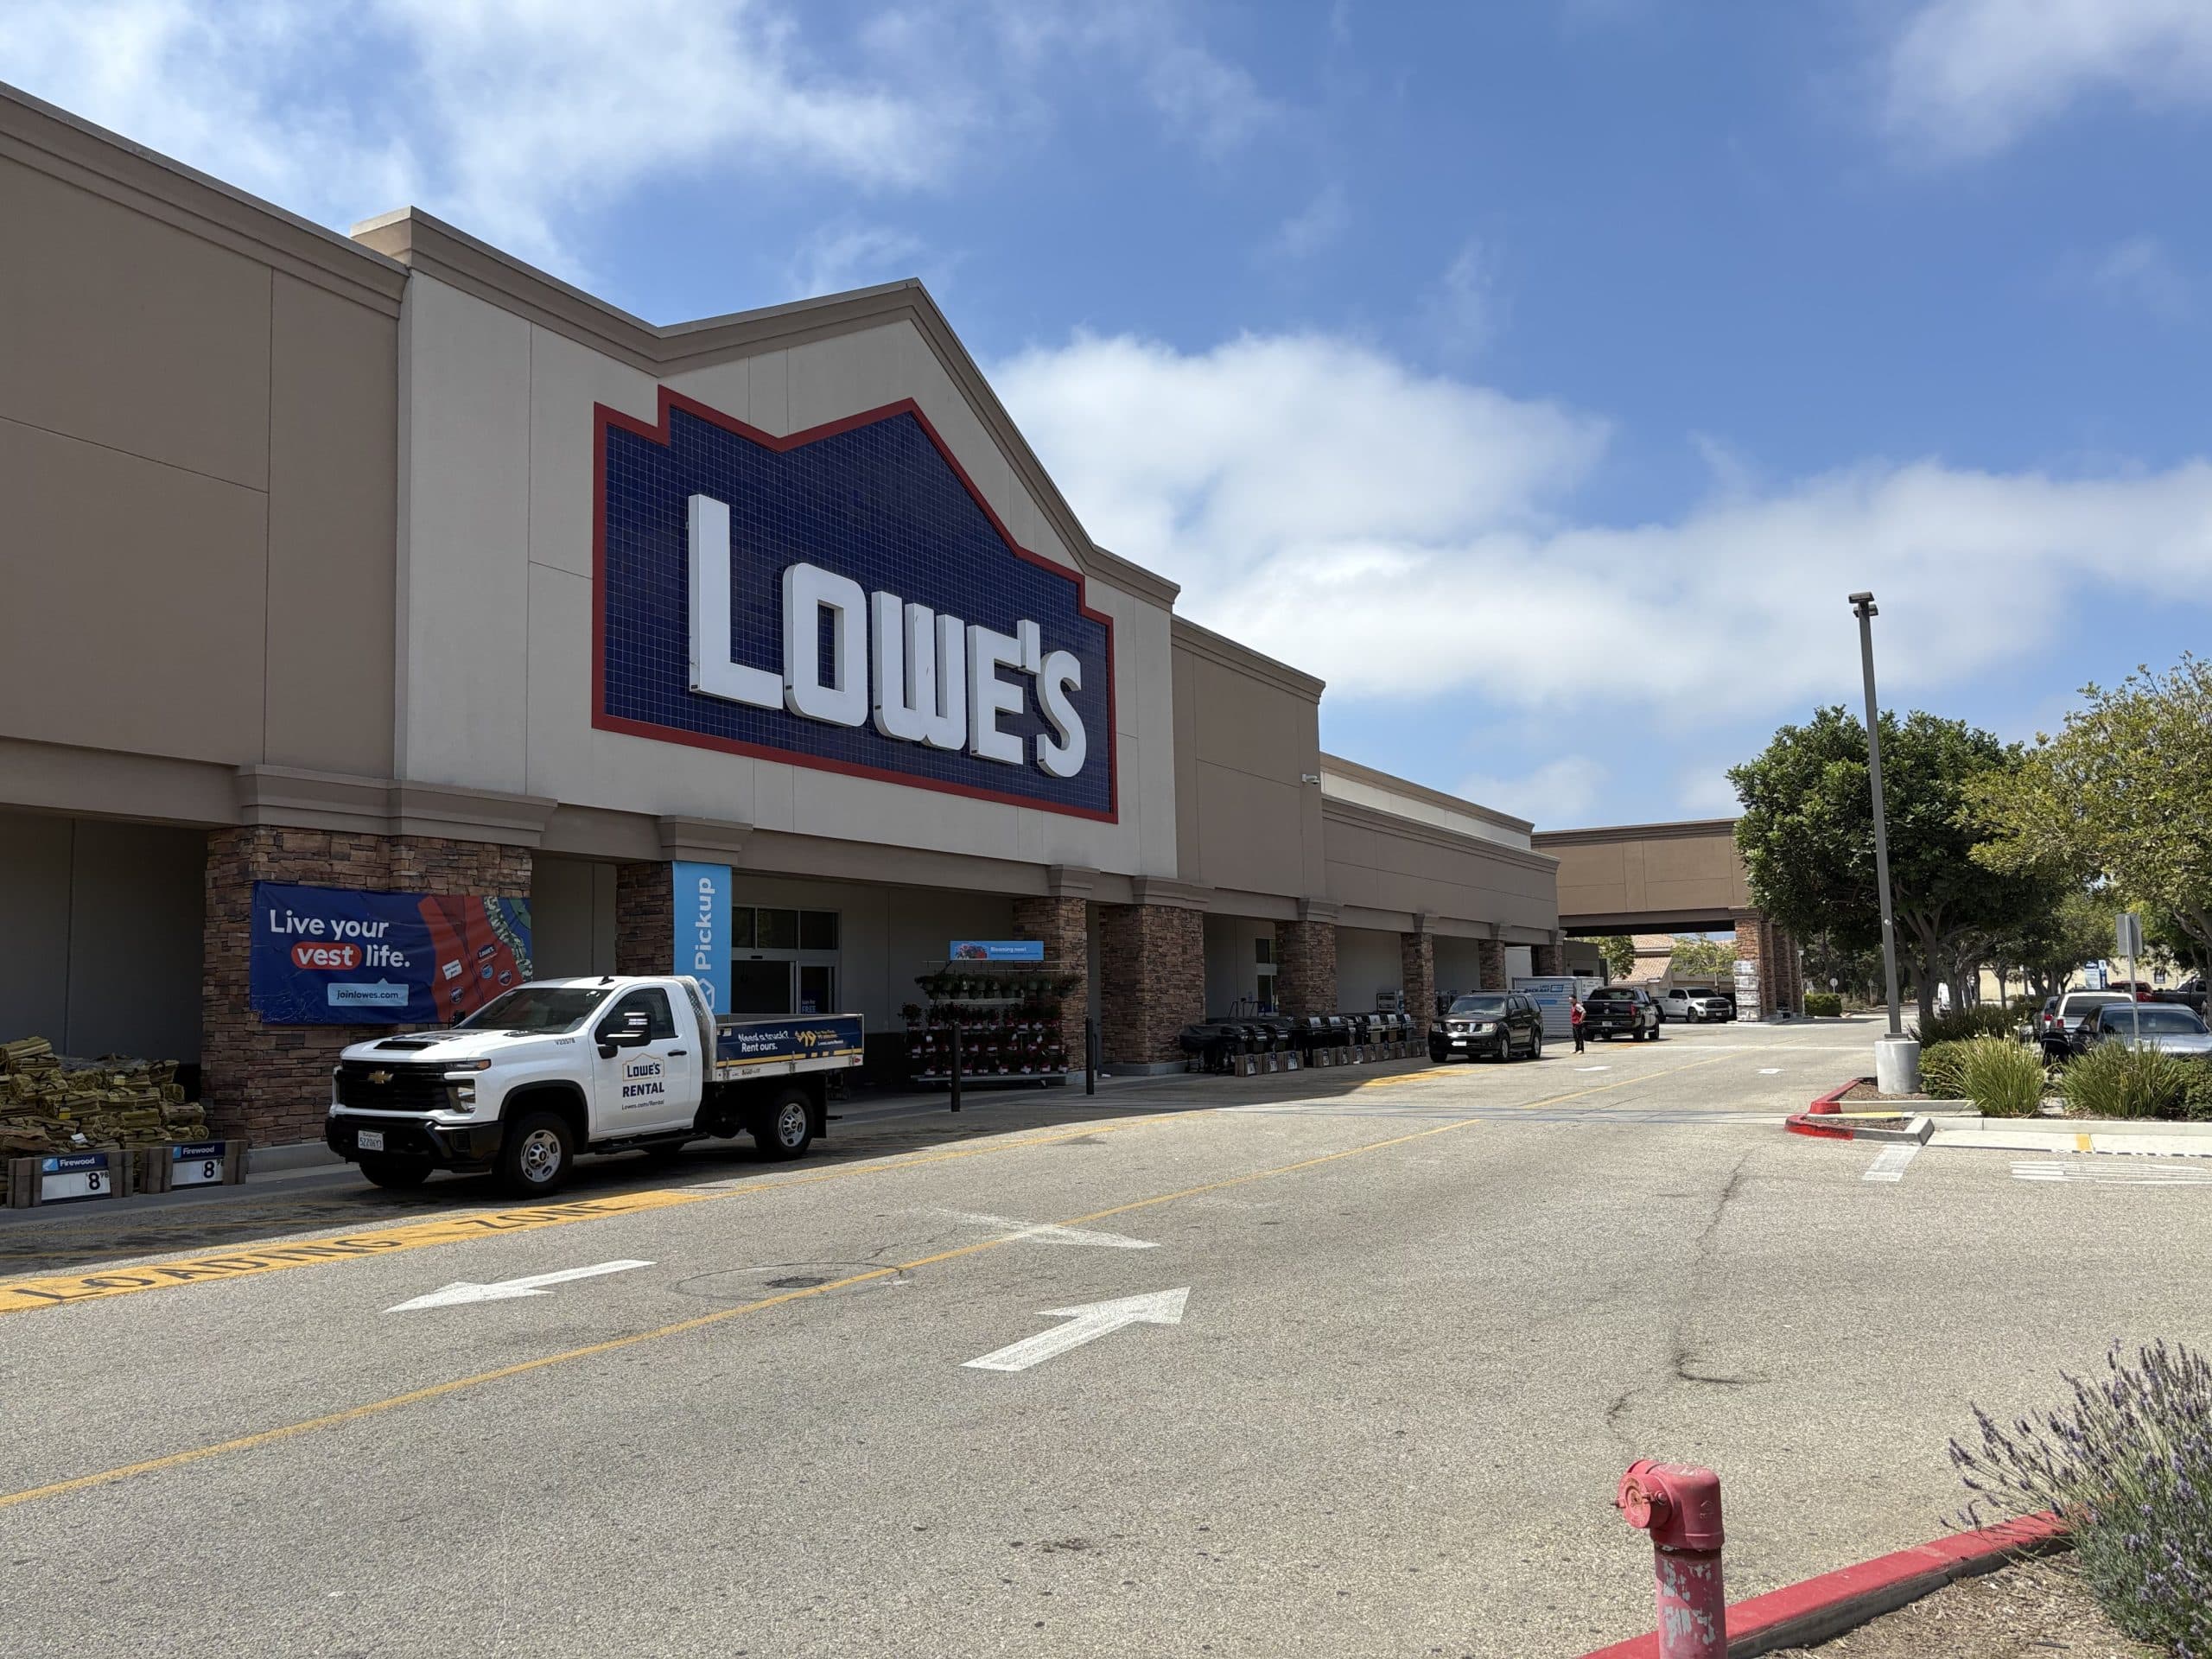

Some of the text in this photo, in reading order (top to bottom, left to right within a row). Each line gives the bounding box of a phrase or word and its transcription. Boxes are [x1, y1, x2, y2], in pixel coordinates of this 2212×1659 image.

[688, 493, 1087, 778] LOWE'S
[270, 909, 389, 941] Live your
[695, 877, 715, 970] Pickup
[297, 944, 410, 967] vest life.
[336, 989, 399, 1001] joinlowes.com
[738, 1033, 760, 1043] Need
[765, 1031, 789, 1041] truck?
[741, 1041, 778, 1052] Rent ours.
[626, 1062, 661, 1078] LOWE'S
[622, 1082, 664, 1097] RENTAL
[621, 1099, 664, 1110] Lowes.com/Rental
[182, 1145, 214, 1155] Firewood
[60, 1157, 96, 1167] Firewood
[13, 1202, 637, 1304] LOADING ZONE
